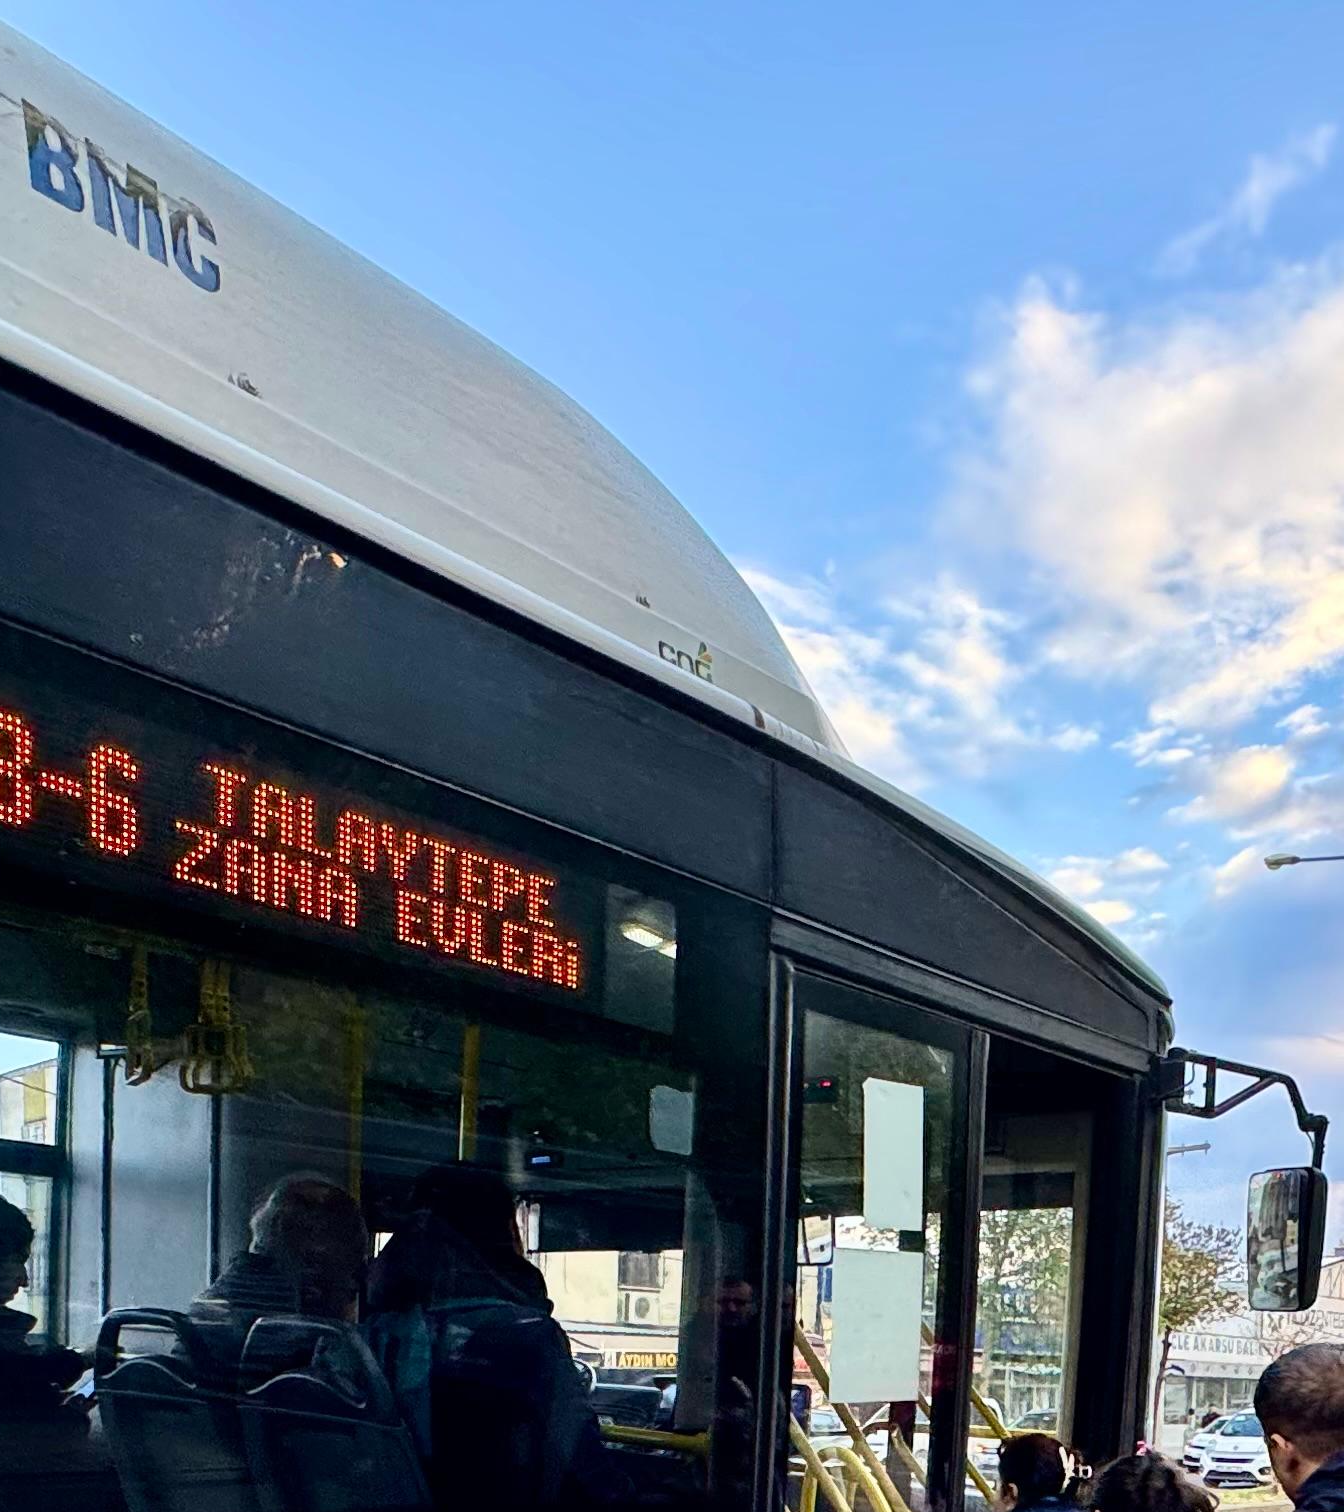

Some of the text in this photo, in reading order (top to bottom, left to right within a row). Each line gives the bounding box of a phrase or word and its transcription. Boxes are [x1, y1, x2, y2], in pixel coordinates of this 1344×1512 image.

[20, 98, 221, 291] BMC
[174, 819, 358, 929] ZANA
[203, 762, 556, 929] TALAYTEPE
